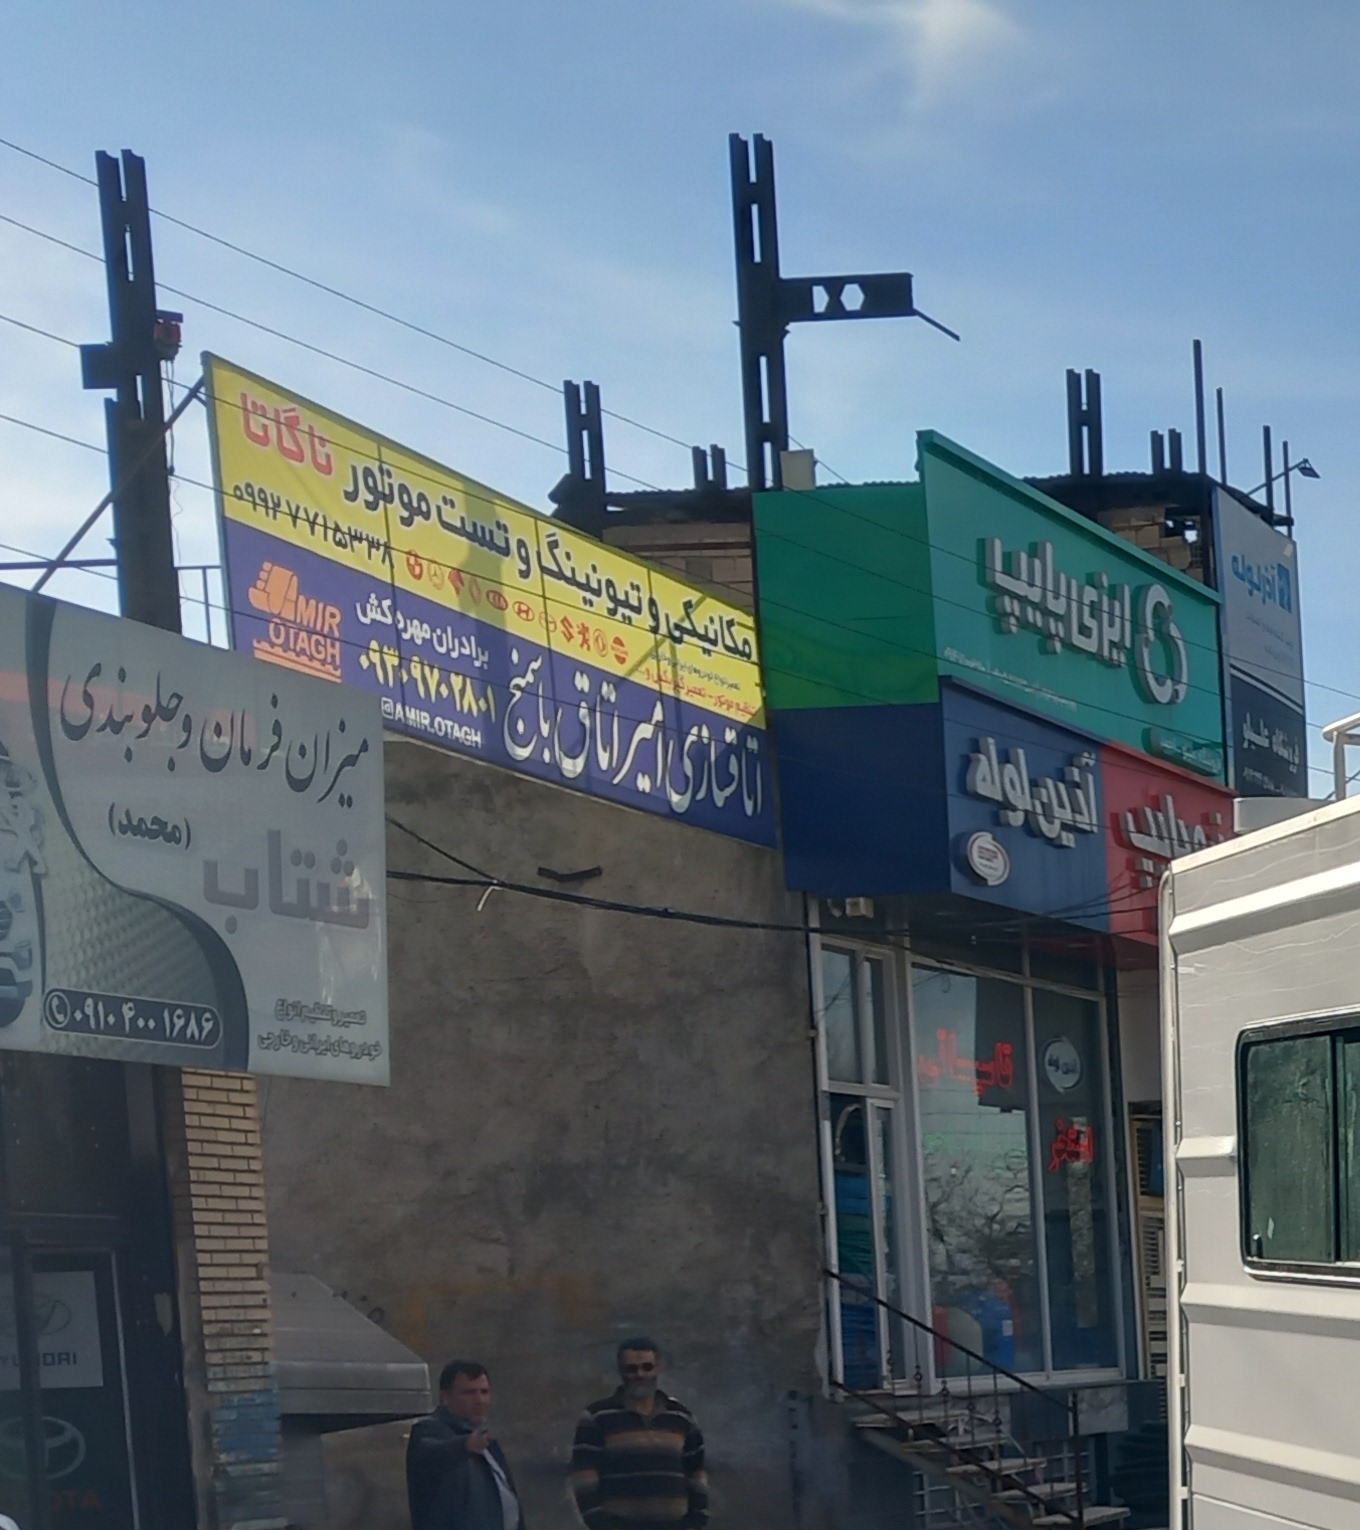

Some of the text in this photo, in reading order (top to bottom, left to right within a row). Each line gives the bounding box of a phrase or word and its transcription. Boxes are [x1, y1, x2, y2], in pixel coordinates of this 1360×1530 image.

[343, 463, 431, 527] موتور
[435, 495, 511, 558] تست
[516, 538, 532, 580] و
[536, 532, 643, 626] تیونینگ
[648, 595, 660, 635] و
[985, 537, 1068, 656] پایپ
[269, 618, 341, 666] OTAGH
[432, 625, 489, 670] برادران
[664, 599, 752, 660] مکانیکی
[200, 692, 283, 773] فرمان
[380, 696, 482, 748] @AMIR.OTAGH
[554, 670, 619, 779] اتاق
[612, 700, 664, 794] امیر
[285, 719, 370, 808] میزان
[203, 829, 371, 935] شتاب
